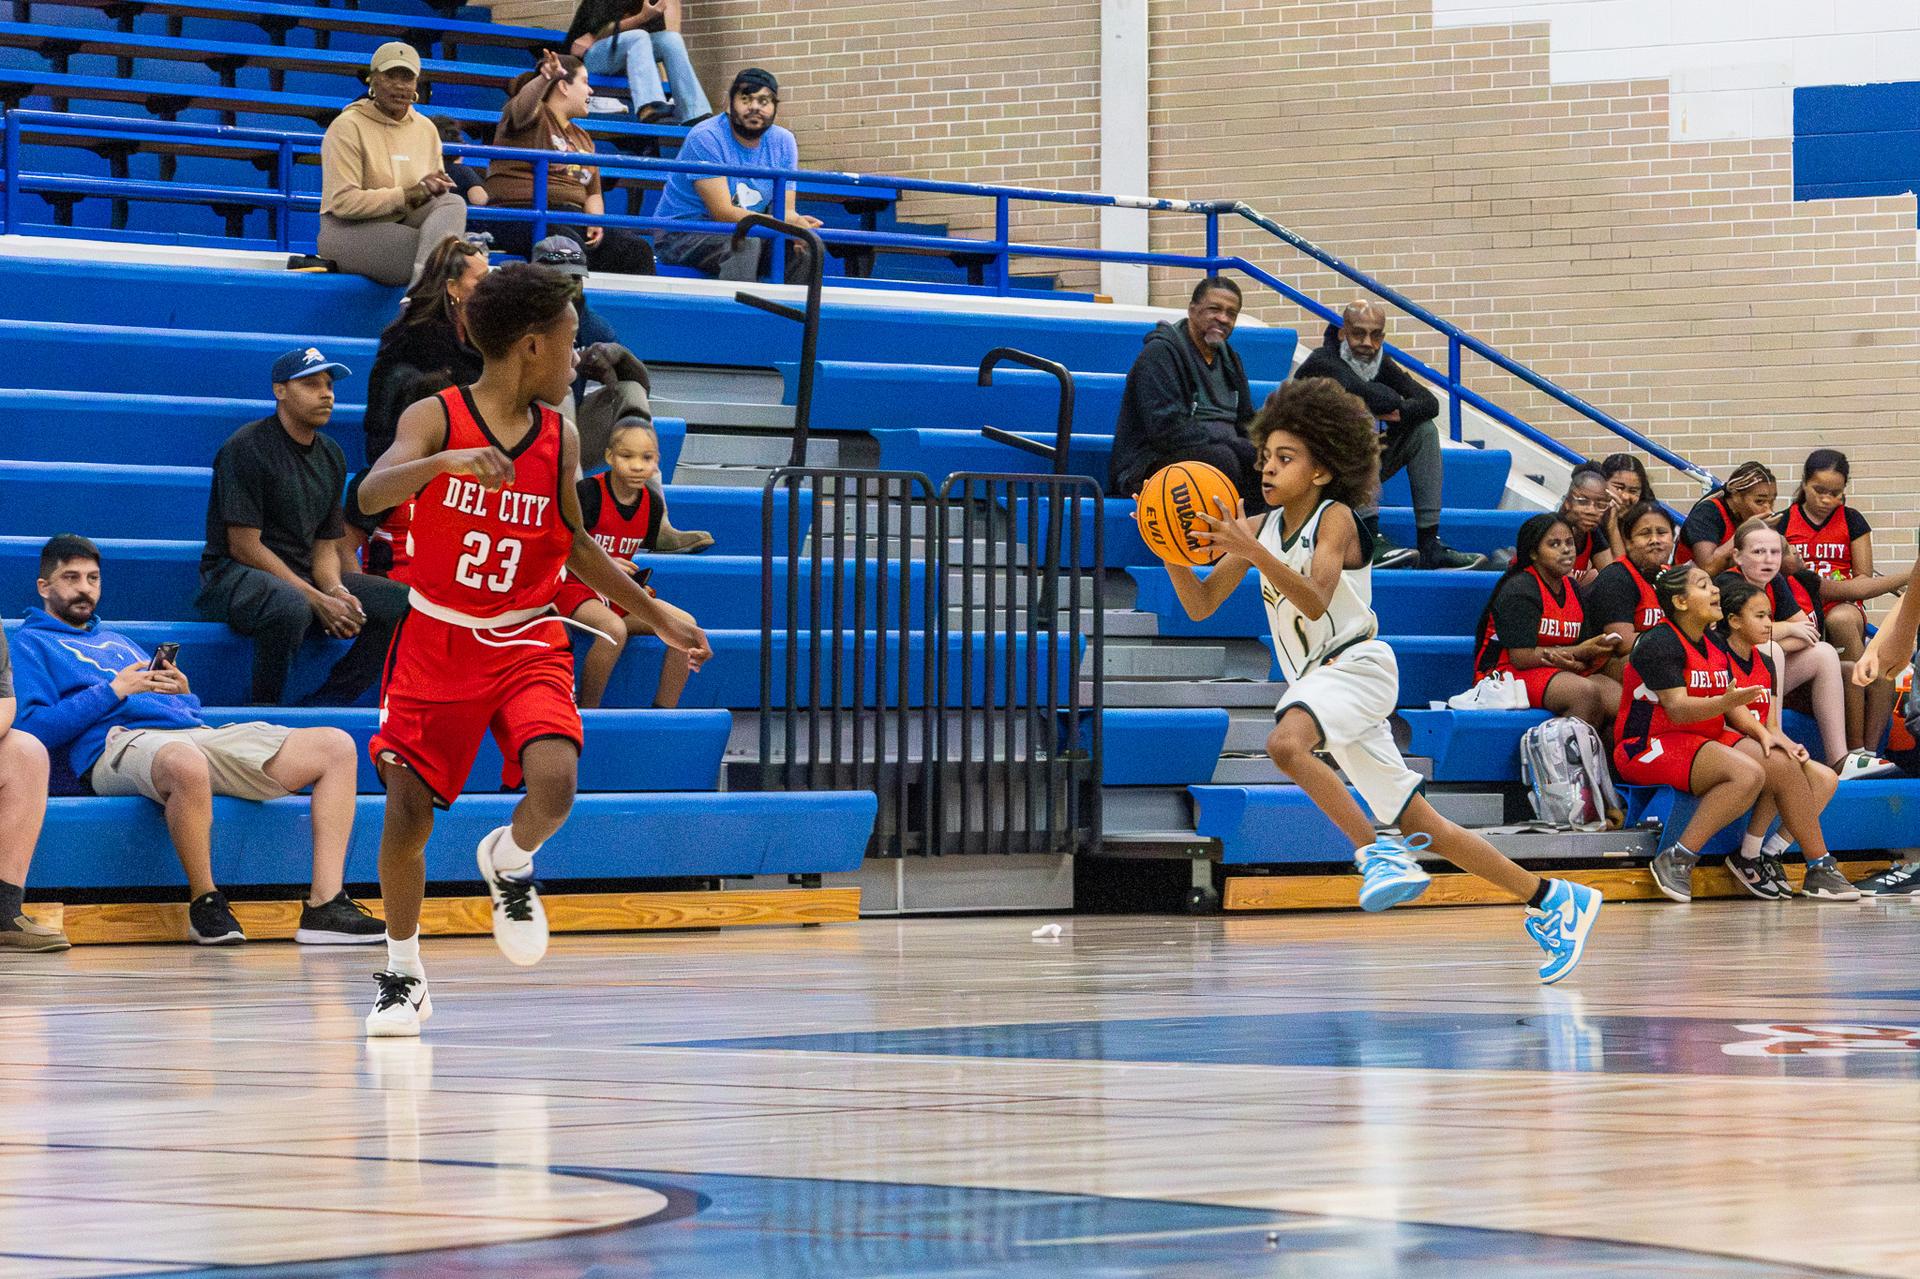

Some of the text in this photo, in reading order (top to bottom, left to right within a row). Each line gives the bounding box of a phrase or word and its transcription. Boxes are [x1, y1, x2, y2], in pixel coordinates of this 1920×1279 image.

[442, 477, 488, 518] DEL
[499, 490, 551, 527] CITY
[1795, 543, 1845, 559] EL CITY
[455, 530, 522, 593] 23
[1538, 617, 1560, 637] DEL
[1690, 670, 1713, 688] DEL
